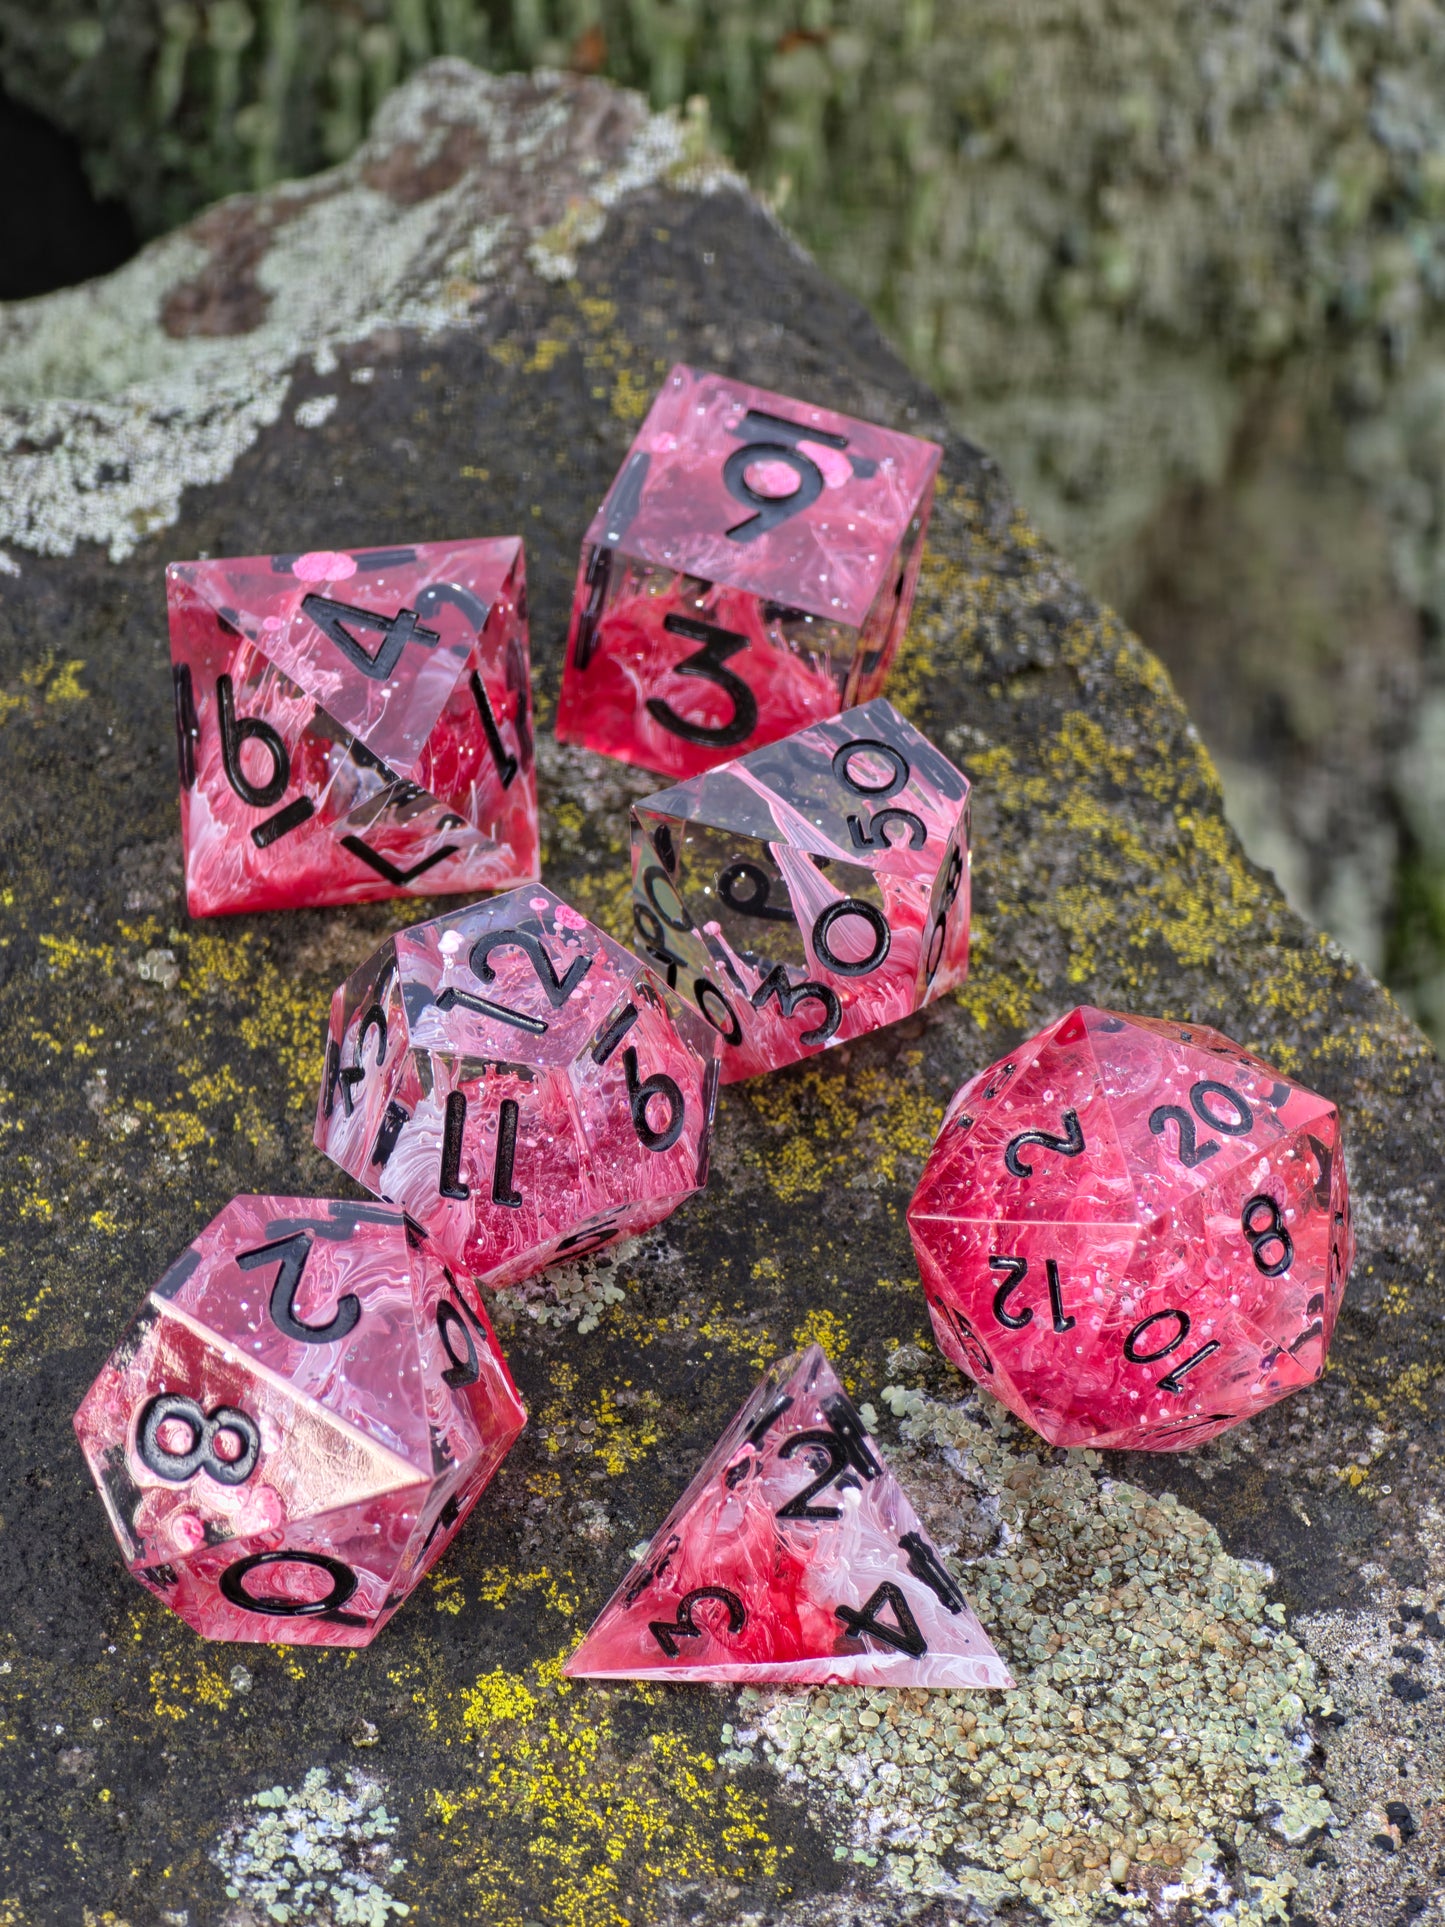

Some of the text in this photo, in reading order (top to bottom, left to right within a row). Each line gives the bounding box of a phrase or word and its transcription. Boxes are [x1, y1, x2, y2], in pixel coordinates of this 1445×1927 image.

[301, 593, 441, 681] 4
[645, 612, 758, 747] 3
[215, 673, 291, 808] 6
[832, 738, 928, 851] 50
[435, 929, 594, 1036] 12
[751, 898, 892, 1046] 30
[439, 1090, 523, 1208] 11
[1004, 1107, 1086, 1179] 2
[1148, 1080, 1254, 1169] 20
[1241, 1194, 1294, 1278] 8
[235, 1231, 362, 1345] 2
[988, 1255, 1076, 1334] 12
[1123, 1308, 1221, 1395] 10
[136, 1391, 261, 1487] 8
[776, 1429, 849, 1521] 2
[218, 1550, 360, 1617] 0
[648, 1586, 749, 1659] 3
[835, 1581, 929, 1660] 4
